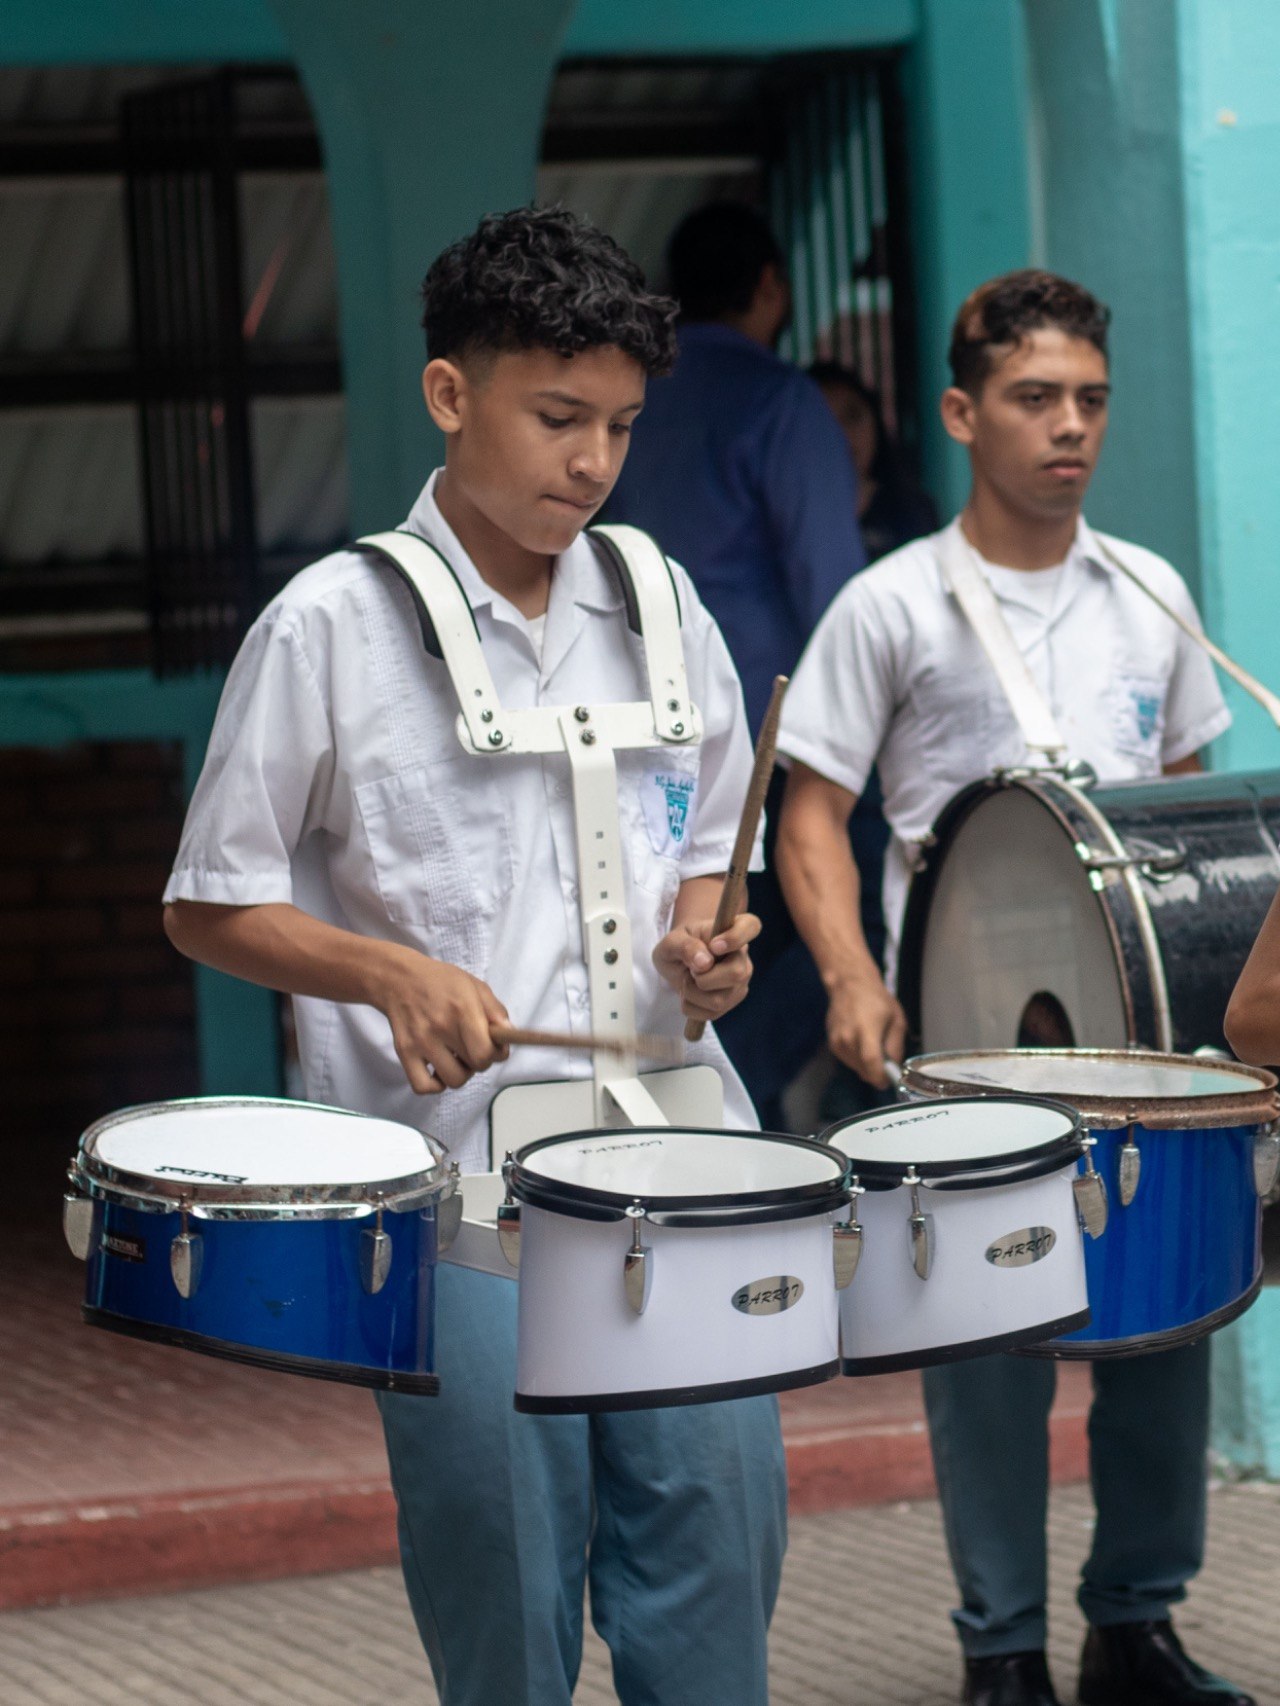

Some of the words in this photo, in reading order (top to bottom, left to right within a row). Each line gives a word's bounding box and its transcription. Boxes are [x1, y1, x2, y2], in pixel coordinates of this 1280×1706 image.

[864, 1110, 949, 1133] PARROT
[991, 1233, 1052, 1259] PARROT
[737, 1283, 799, 1307] PARROT
